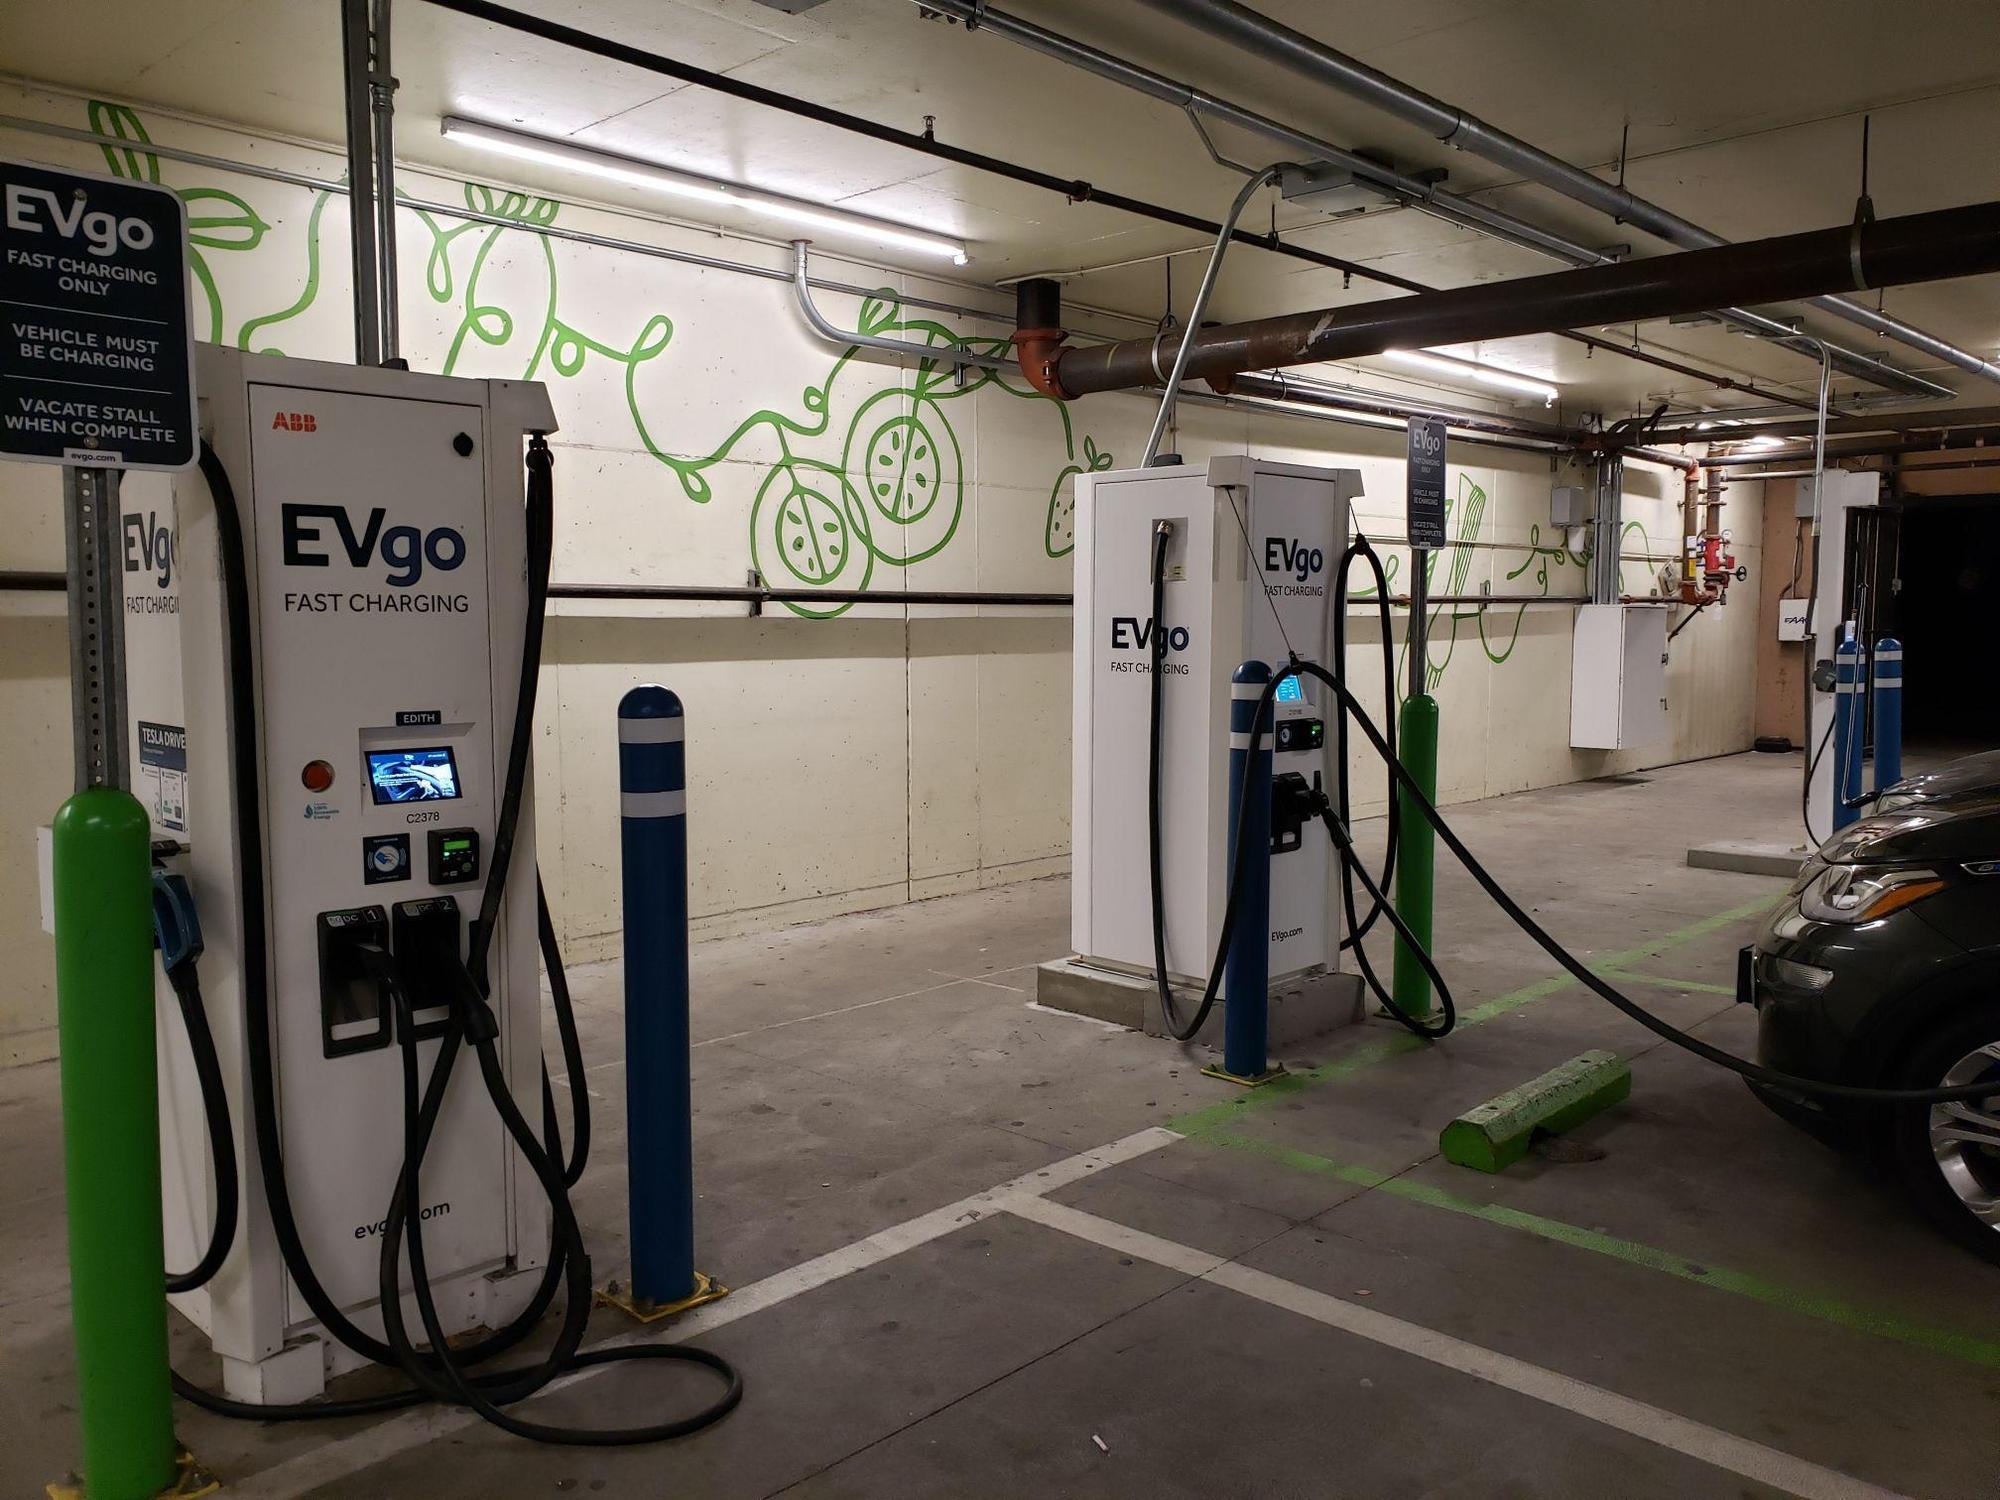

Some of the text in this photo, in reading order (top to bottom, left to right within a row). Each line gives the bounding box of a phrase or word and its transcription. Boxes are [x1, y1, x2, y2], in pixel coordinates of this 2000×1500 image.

[6, 184, 154, 257] EVgo
[7, 249, 158, 285] FAST CHARGING
[58, 276, 111, 296] ONLY
[12, 323, 160, 354] VEHICLE MUST
[20, 343, 155, 371] BE CHARGING
[19, 397, 161, 424] VACATE STALL
[4, 415, 177, 443] WHEN COMPLETE
[271, 412, 317, 433] ABB
[1413, 428, 1440, 456] EVgo
[71, 453, 116, 463] evgo.com
[123, 511, 174, 589] EVg
[281, 503, 466, 587] EVgo
[1265, 537, 1323, 582] EVgo
[1264, 585, 1323, 597] FAST CHARGING
[127, 596, 179, 614] FAST CHARGI
[284, 593, 469, 613] FAST CHARGING
[1110, 661, 1189, 675] FAST CHGING
[403, 713, 436, 724] EDITH
[142, 727, 164, 746] TESLA
[406, 811, 440, 824] C2378
[367, 909, 377, 921] 1
